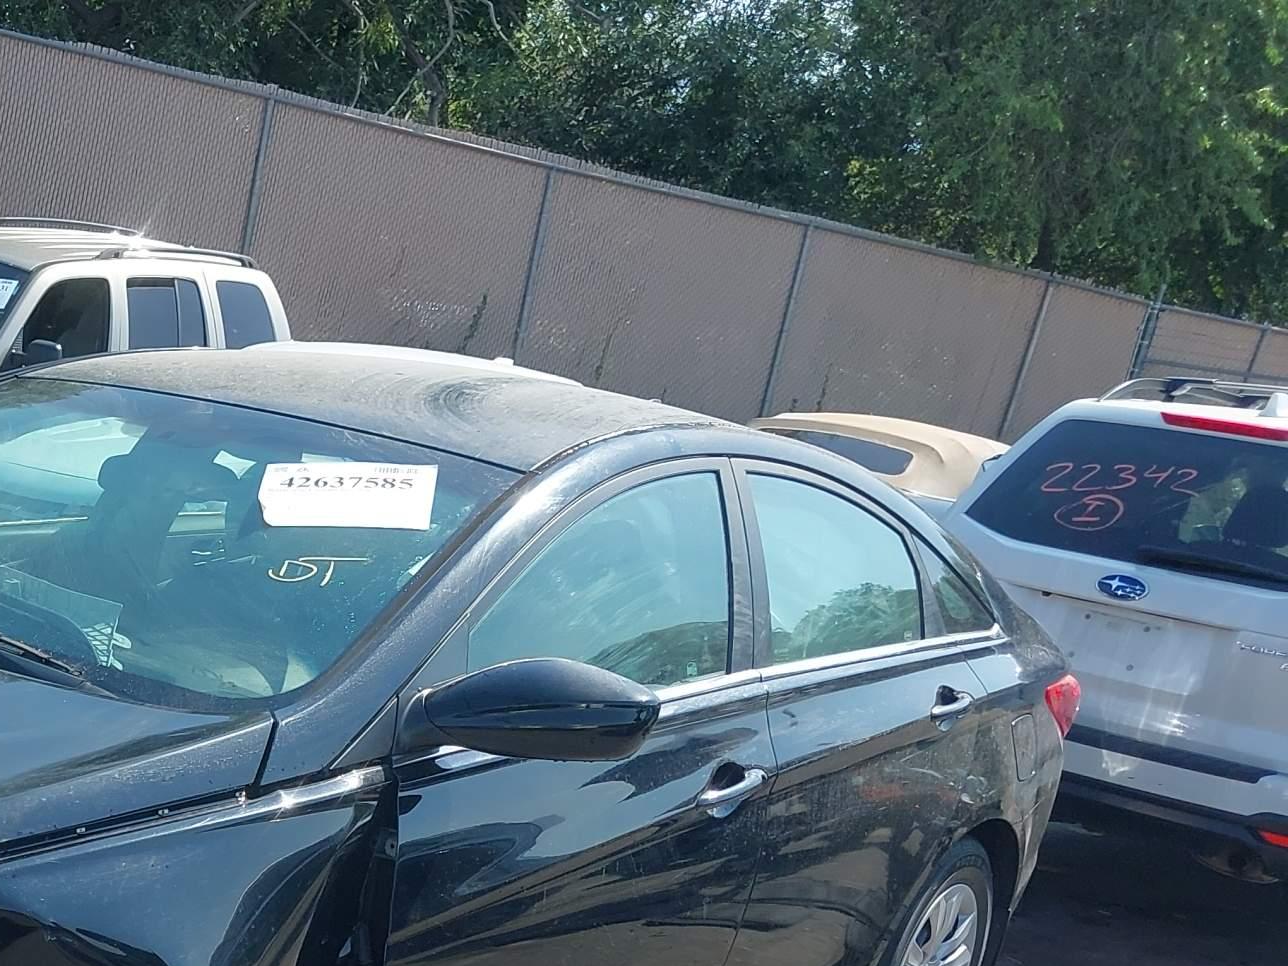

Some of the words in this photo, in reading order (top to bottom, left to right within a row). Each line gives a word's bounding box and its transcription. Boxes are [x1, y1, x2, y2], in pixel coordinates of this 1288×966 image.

[279, 475, 415, 491] 42637585
[1040, 462, 1201, 498] 22342
[267, 556, 370, 588] DT
